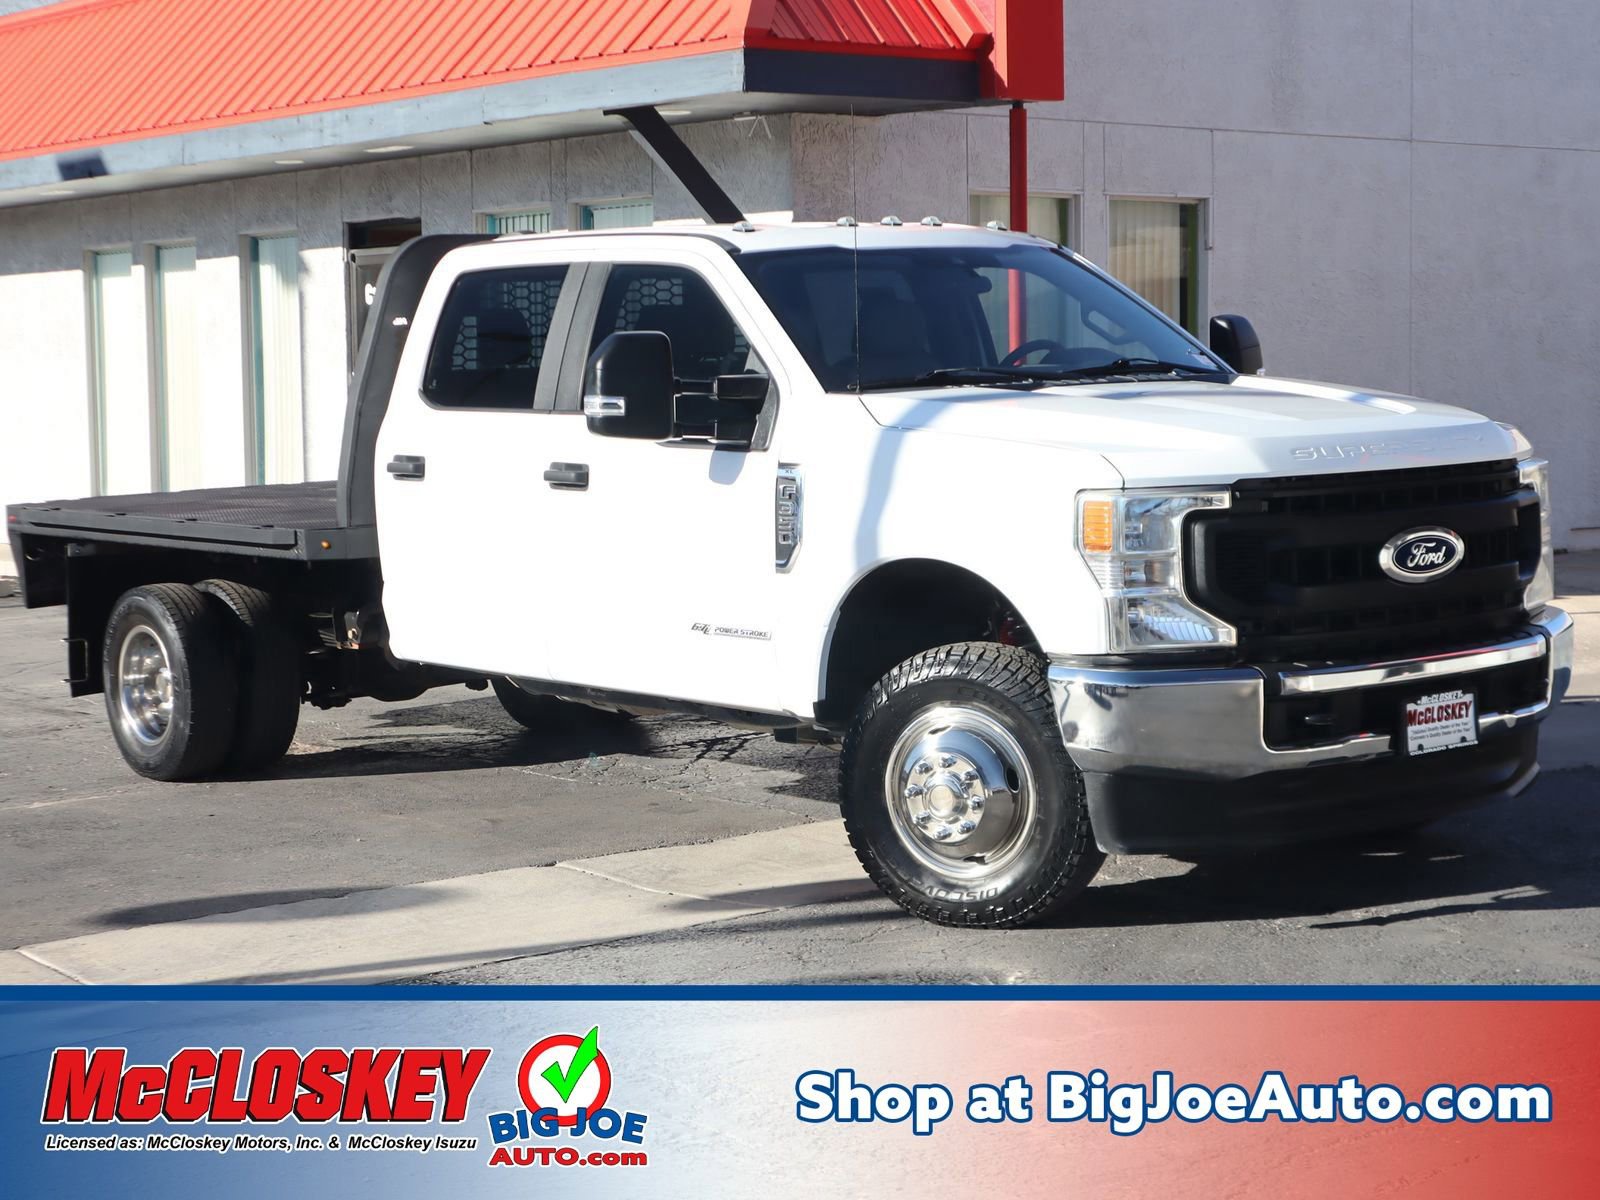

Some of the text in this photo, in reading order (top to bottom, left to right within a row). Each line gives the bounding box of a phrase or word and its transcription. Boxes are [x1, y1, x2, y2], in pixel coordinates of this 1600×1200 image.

[1407, 542, 1446, 567] Ford
[714, 626, 739, 635] POWER
[740, 628, 769, 638] STROKE
